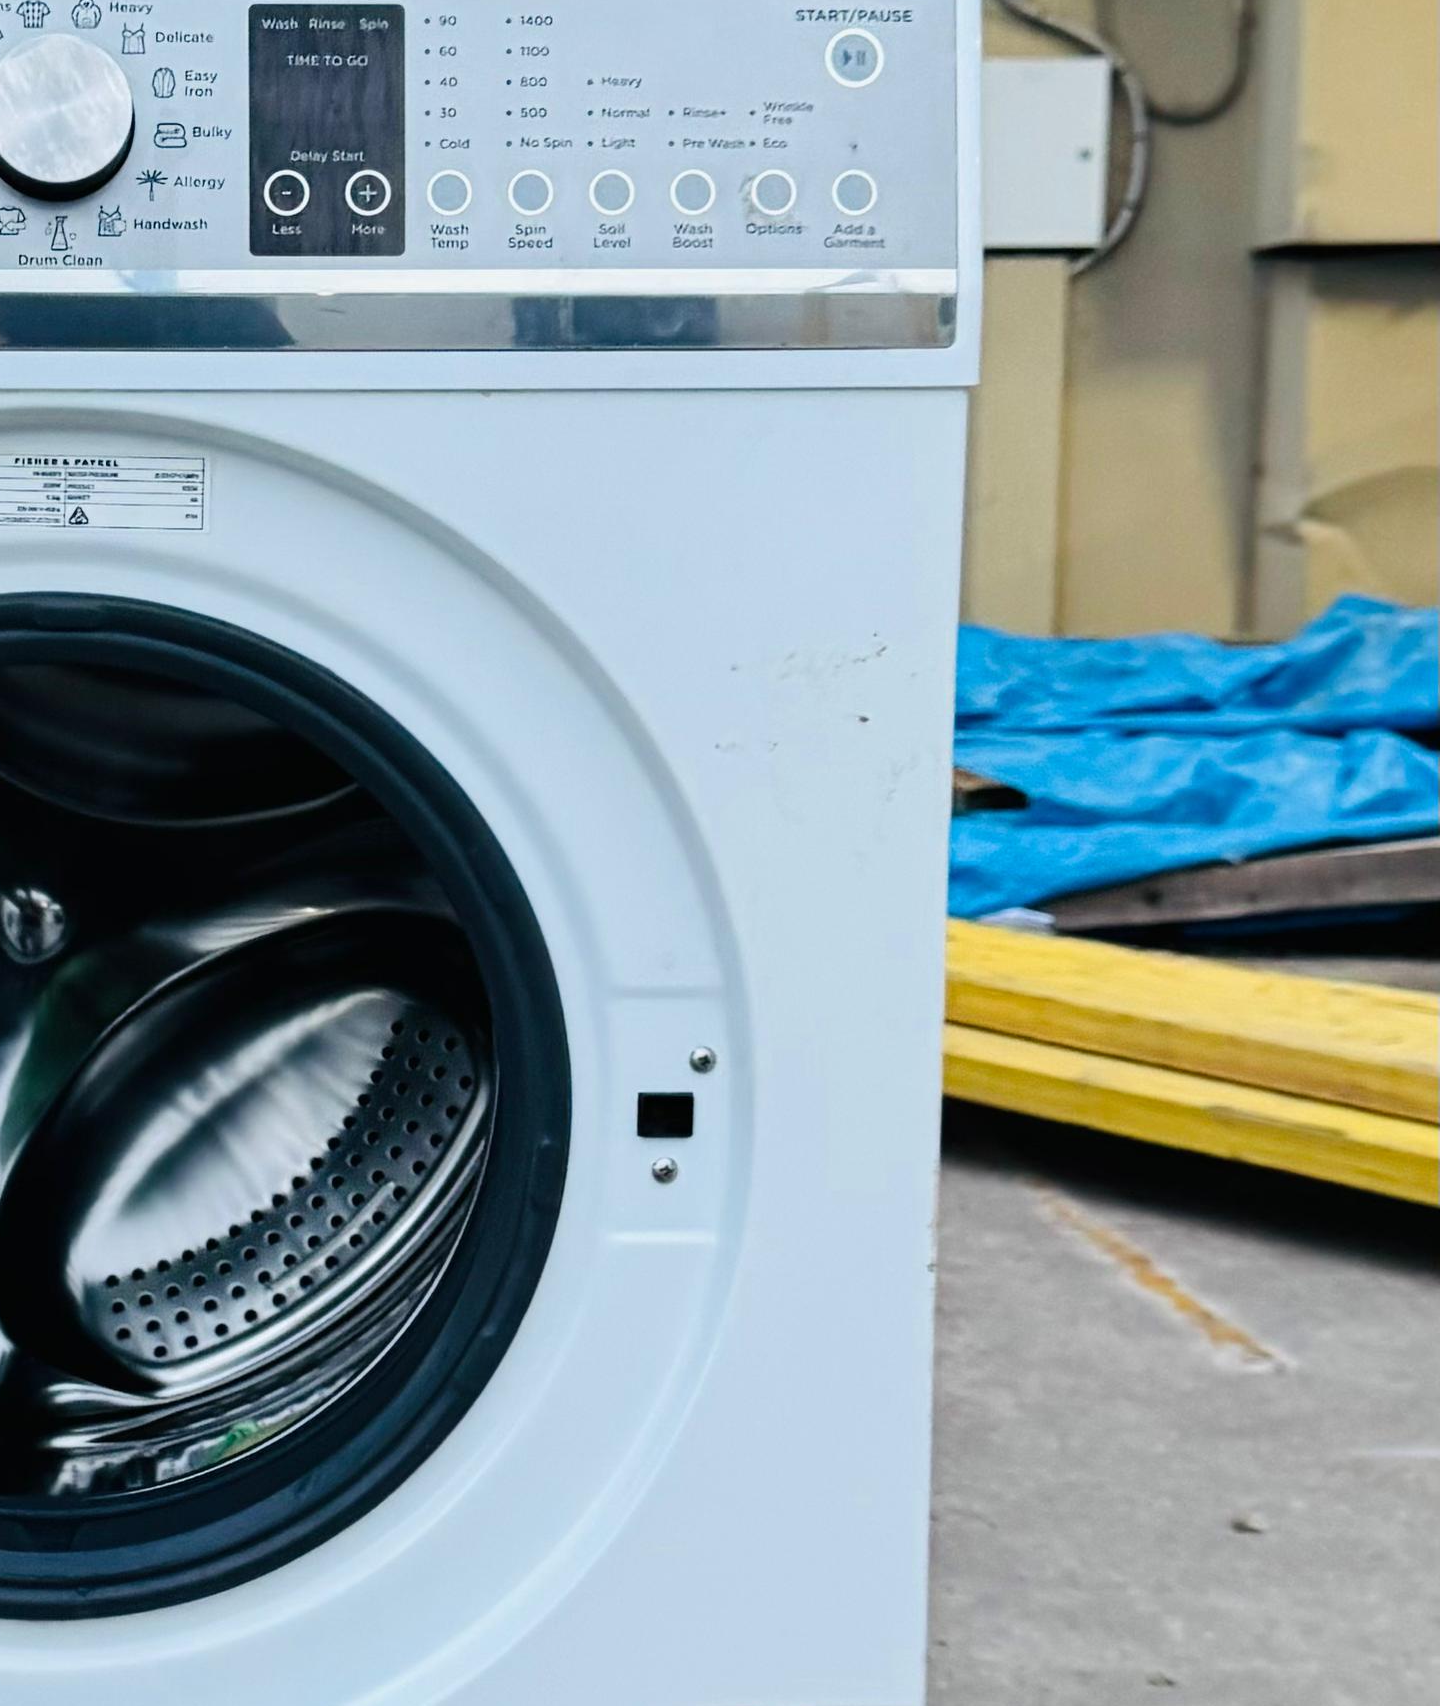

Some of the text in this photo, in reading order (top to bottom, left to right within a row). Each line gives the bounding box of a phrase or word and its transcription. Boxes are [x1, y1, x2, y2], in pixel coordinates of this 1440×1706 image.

[110, 2, 153, 15] Heavy
[439, 15, 457, 26] 90
[520, 15, 553, 26] 1400
[794, 8, 913, 23] START/PAUSE
[261, 16, 299, 30] Wash
[308, 17, 346, 30] Rinse
[359, 17, 389, 31] Spin
[155, 31, 215, 43] Delicate
[439, 46, 457, 57] 60
[520, 46, 550, 57] 1100
[287, 55, 369, 66] TIME TO GO
[185, 70, 217, 84] Easy
[439, 77, 458, 87] 40
[520, 76, 548, 87] 800
[601, 76, 642, 89] Heavy
[185, 86, 213, 97] Iron
[439, 107, 457, 118] 30
[520, 107, 548, 118] 500
[601, 107, 651, 118] Normal
[763, 114, 792, 125] Free
[192, 127, 232, 140] Bulky
[439, 138, 470, 149] Cold
[520, 137, 573, 150] No Spin
[601, 137, 636, 150] Light
[682, 138, 746, 149] Pre Wash
[763, 137, 788, 149] Eco
[290, 150, 365, 163] Delay Start
[173, 176, 226, 190] Allergy
[133, 218, 208, 230] Handwash
[272, 223, 302, 235] Less
[351, 224, 386, 235] More
[430, 224, 469, 235] Wash
[515, 224, 546, 236] Spin
[598, 224, 626, 235] Soil
[673, 223, 713, 235] Wash
[745, 223, 803, 236] Options
[832, 224, 859, 235] Add
[431, 237, 469, 250] Temp
[508, 237, 553, 250] Speed
[593, 237, 631, 248] Level
[672, 237, 713, 249] Boost
[823, 238, 886, 249] Garment
[18, 254, 103, 267] Drum Clean
